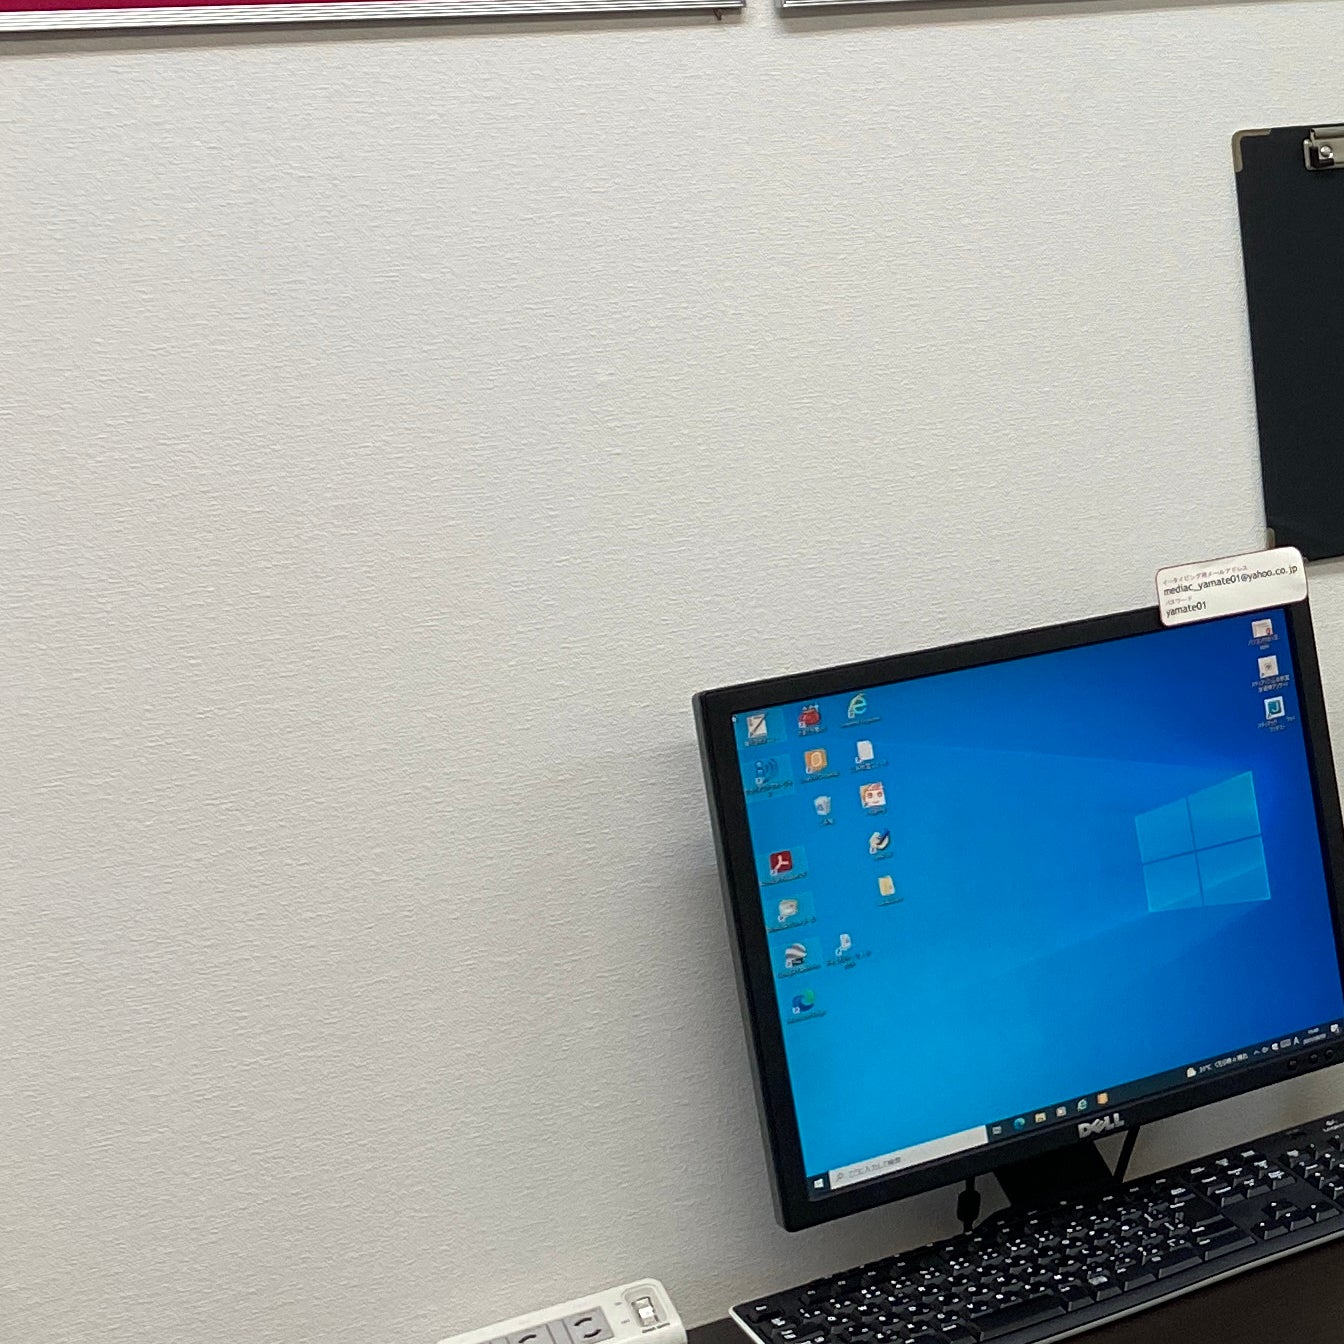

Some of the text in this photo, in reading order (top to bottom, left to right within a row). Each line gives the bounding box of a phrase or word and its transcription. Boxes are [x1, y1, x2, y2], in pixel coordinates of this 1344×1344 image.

[1163, 565, 1298, 596] mediac_yamate01@yahoo.co.jp
[1166, 601, 1207, 618] yamate01
[1077, 1112, 1125, 1139] DELL
